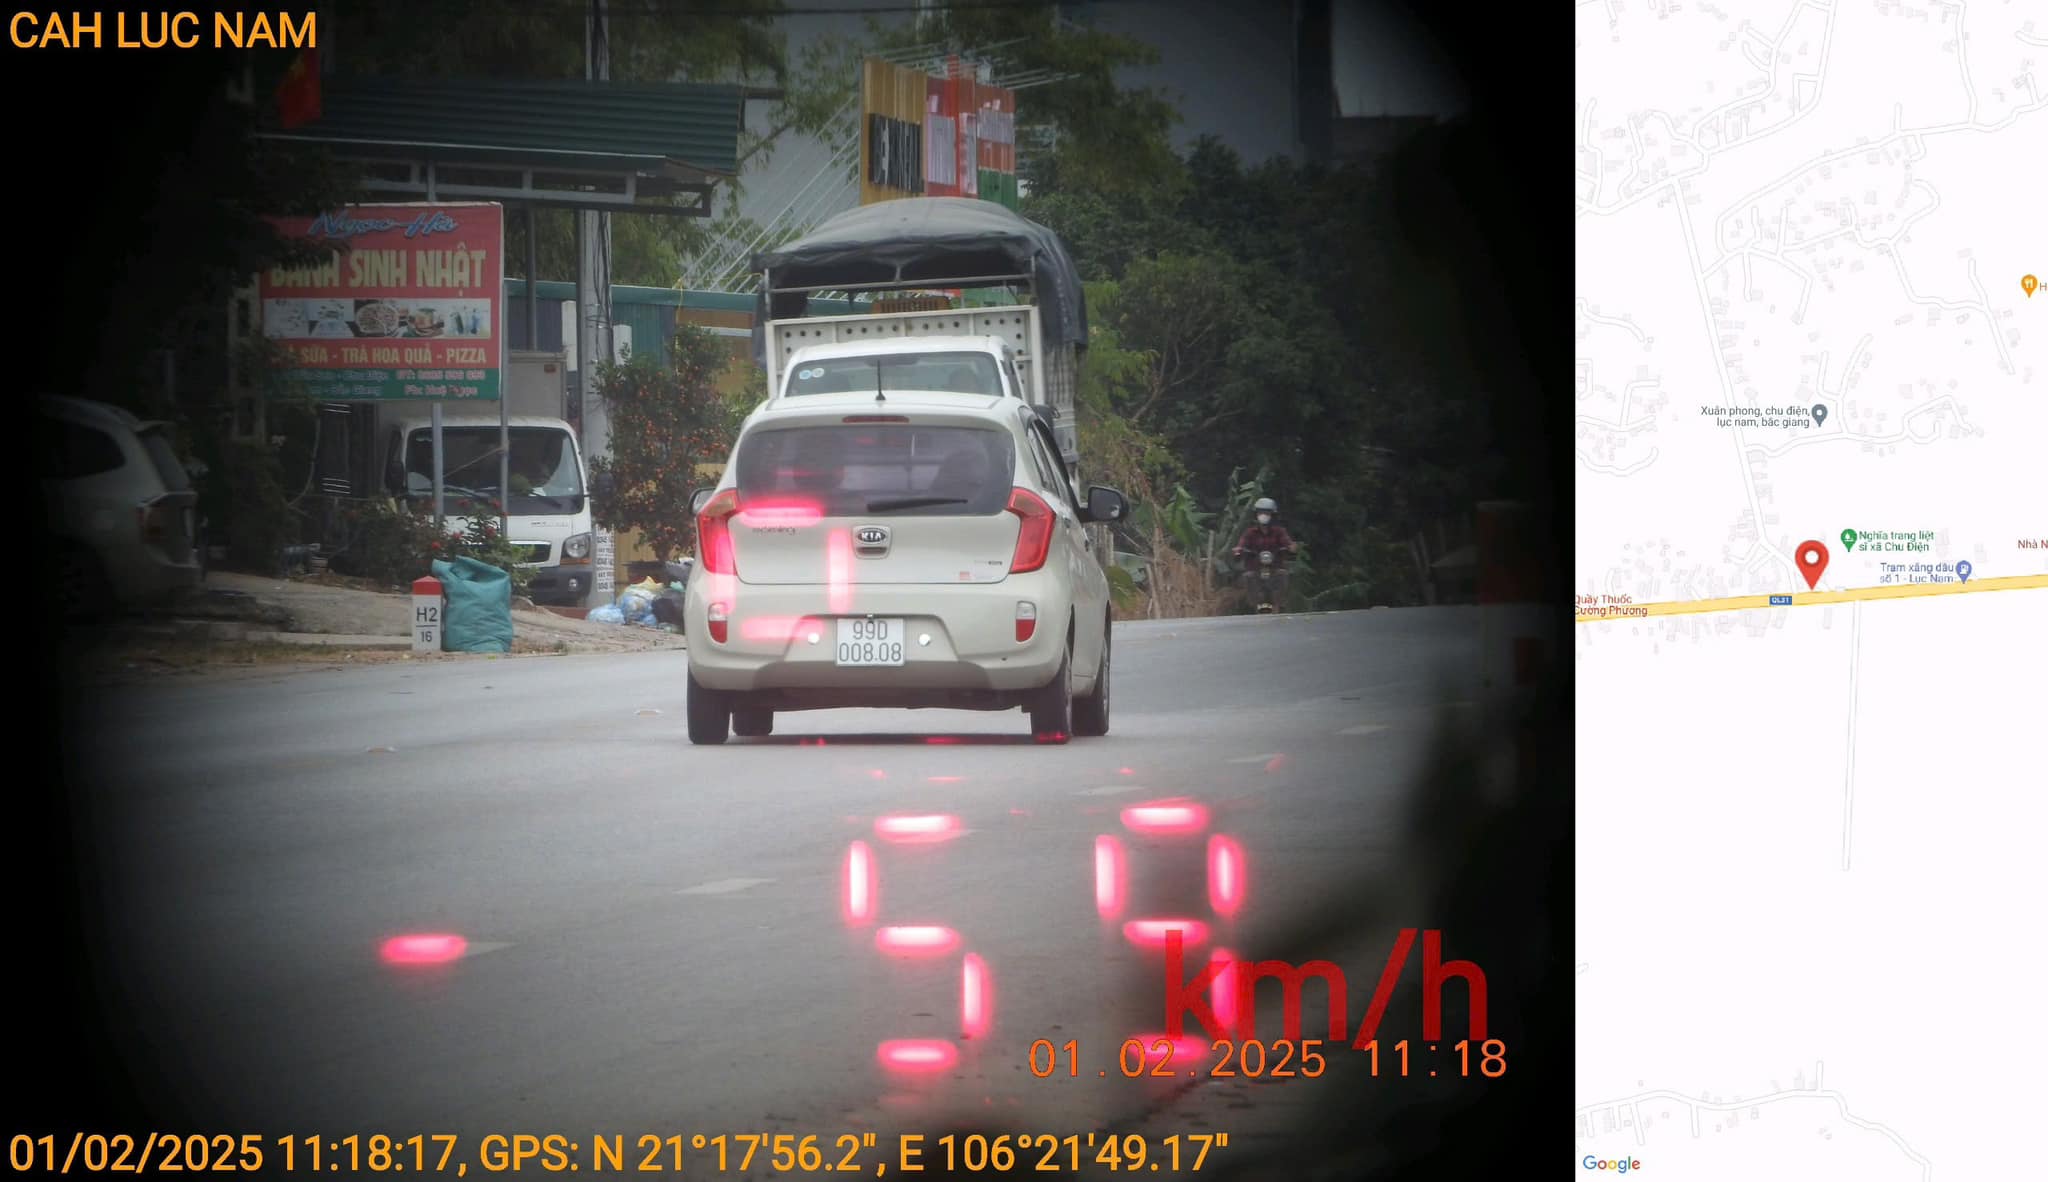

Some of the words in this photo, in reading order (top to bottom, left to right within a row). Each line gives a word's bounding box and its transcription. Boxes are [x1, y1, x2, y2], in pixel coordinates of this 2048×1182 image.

[350, 249, 407, 288] SINH
[416, 241, 487, 297] NHẬT
[342, 347, 369, 364] TRÀ
[372, 349, 399, 364] HOA
[404, 343, 432, 365] QUẢ
[446, 348, 487, 364] PIZZA
[861, 532, 882, 541] KIA
[416, 607, 438, 623] H2
[421, 631, 433, 643] 16
[853, 620, 888, 640] 99D
[839, 642, 902, 662] 008.08
